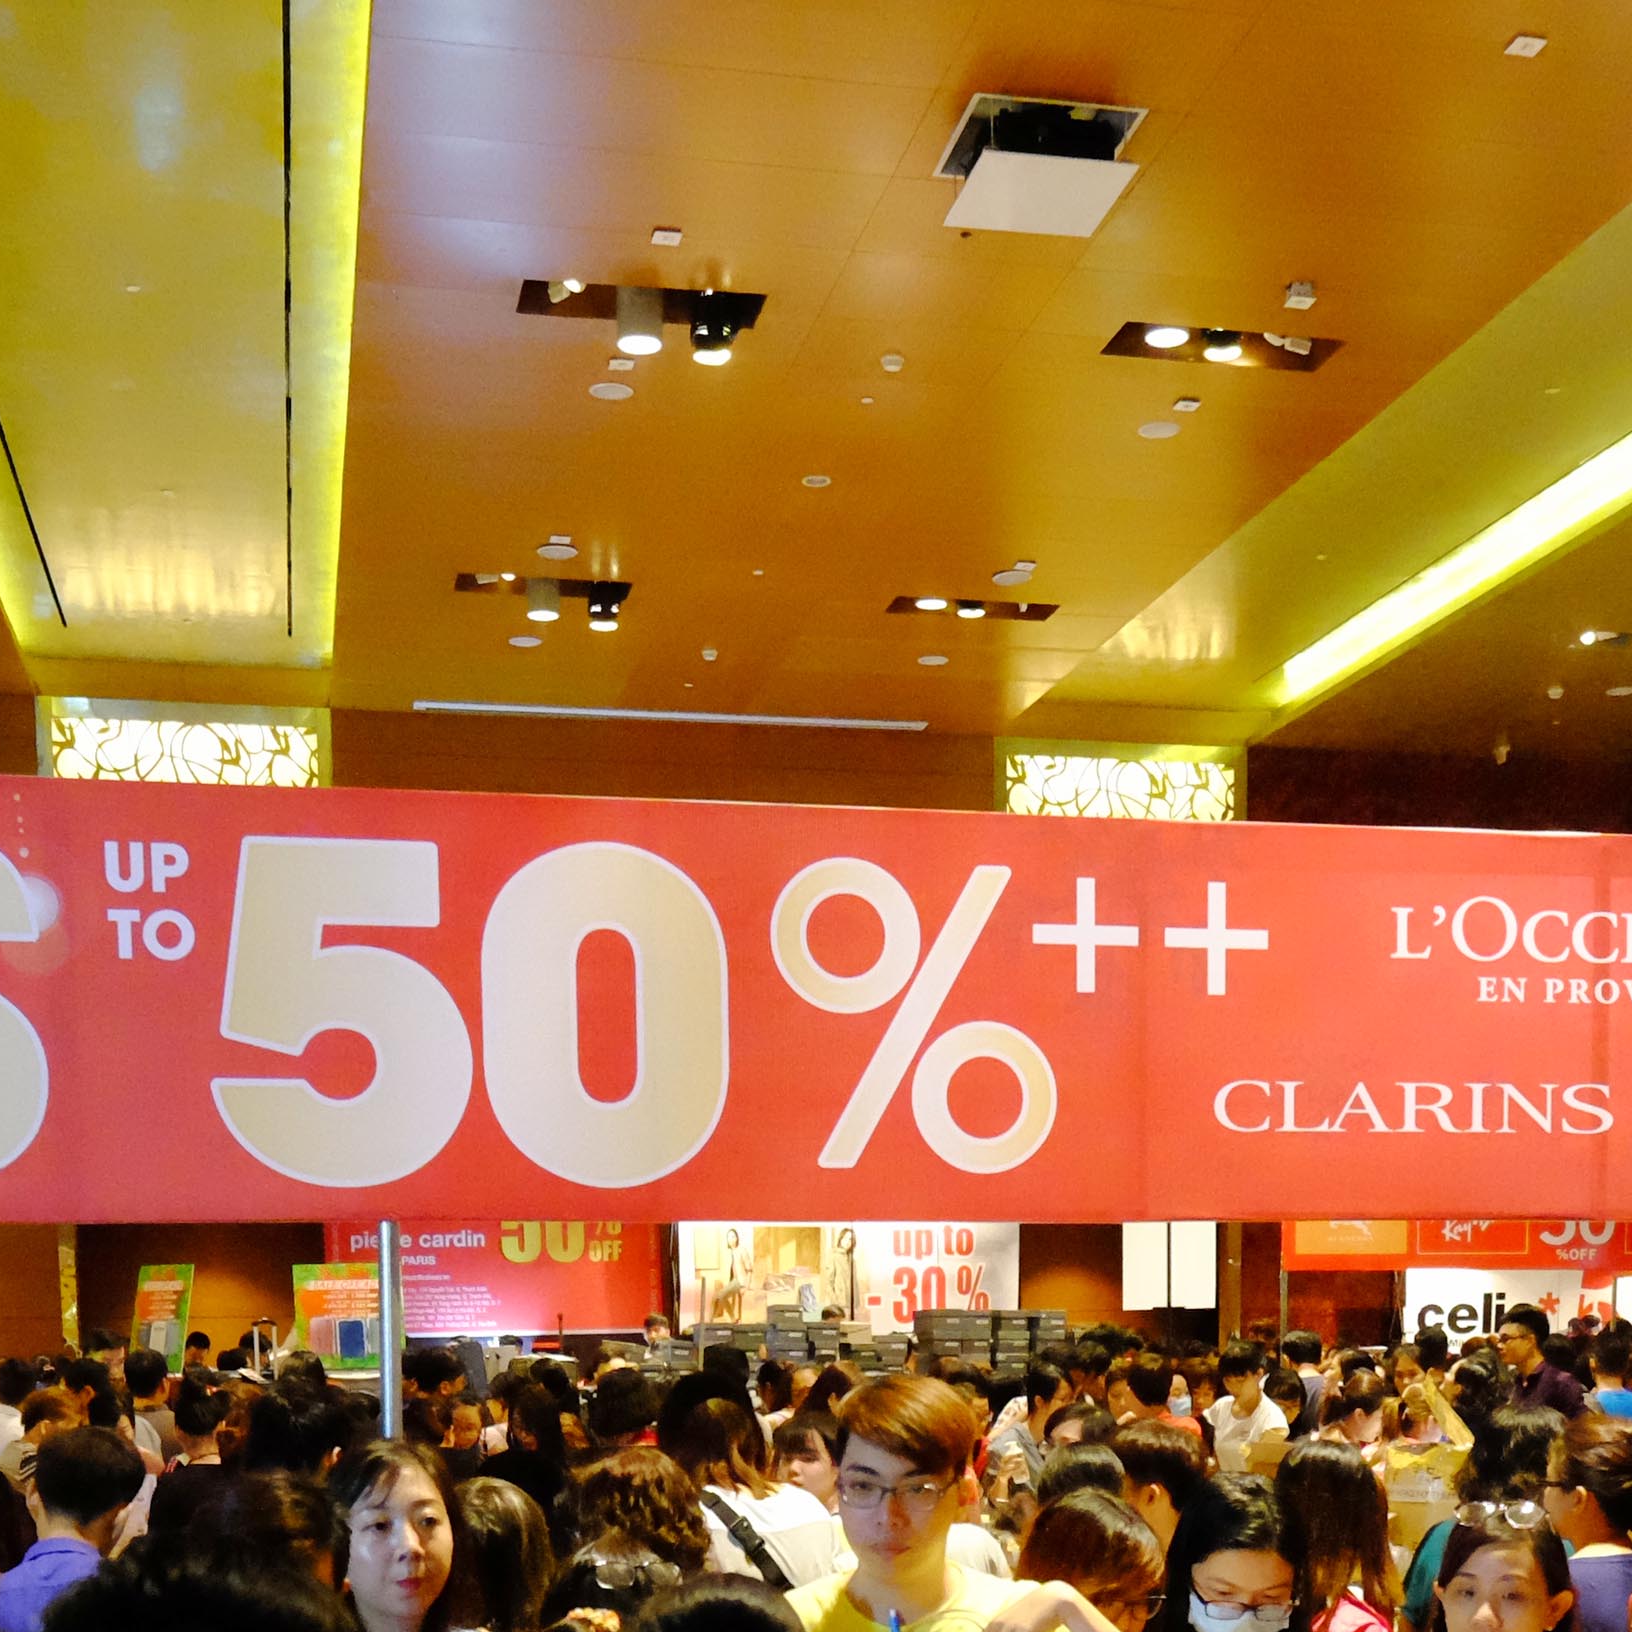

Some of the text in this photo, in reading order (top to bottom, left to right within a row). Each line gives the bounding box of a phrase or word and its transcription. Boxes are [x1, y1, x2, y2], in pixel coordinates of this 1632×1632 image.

[103, 840, 190, 894] UP
[107, 907, 196, 963] TO
[1476, 976, 1528, 1004] EN
[1213, 1078, 1615, 1136] CLARINS
[350, 1231, 412, 1252] piee
[419, 1230, 486, 1248] cardin
[588, 1240, 622, 1262] OFF
[893, 1225, 974, 1260] up to
[401, 1255, 436, 1267] PARIS
